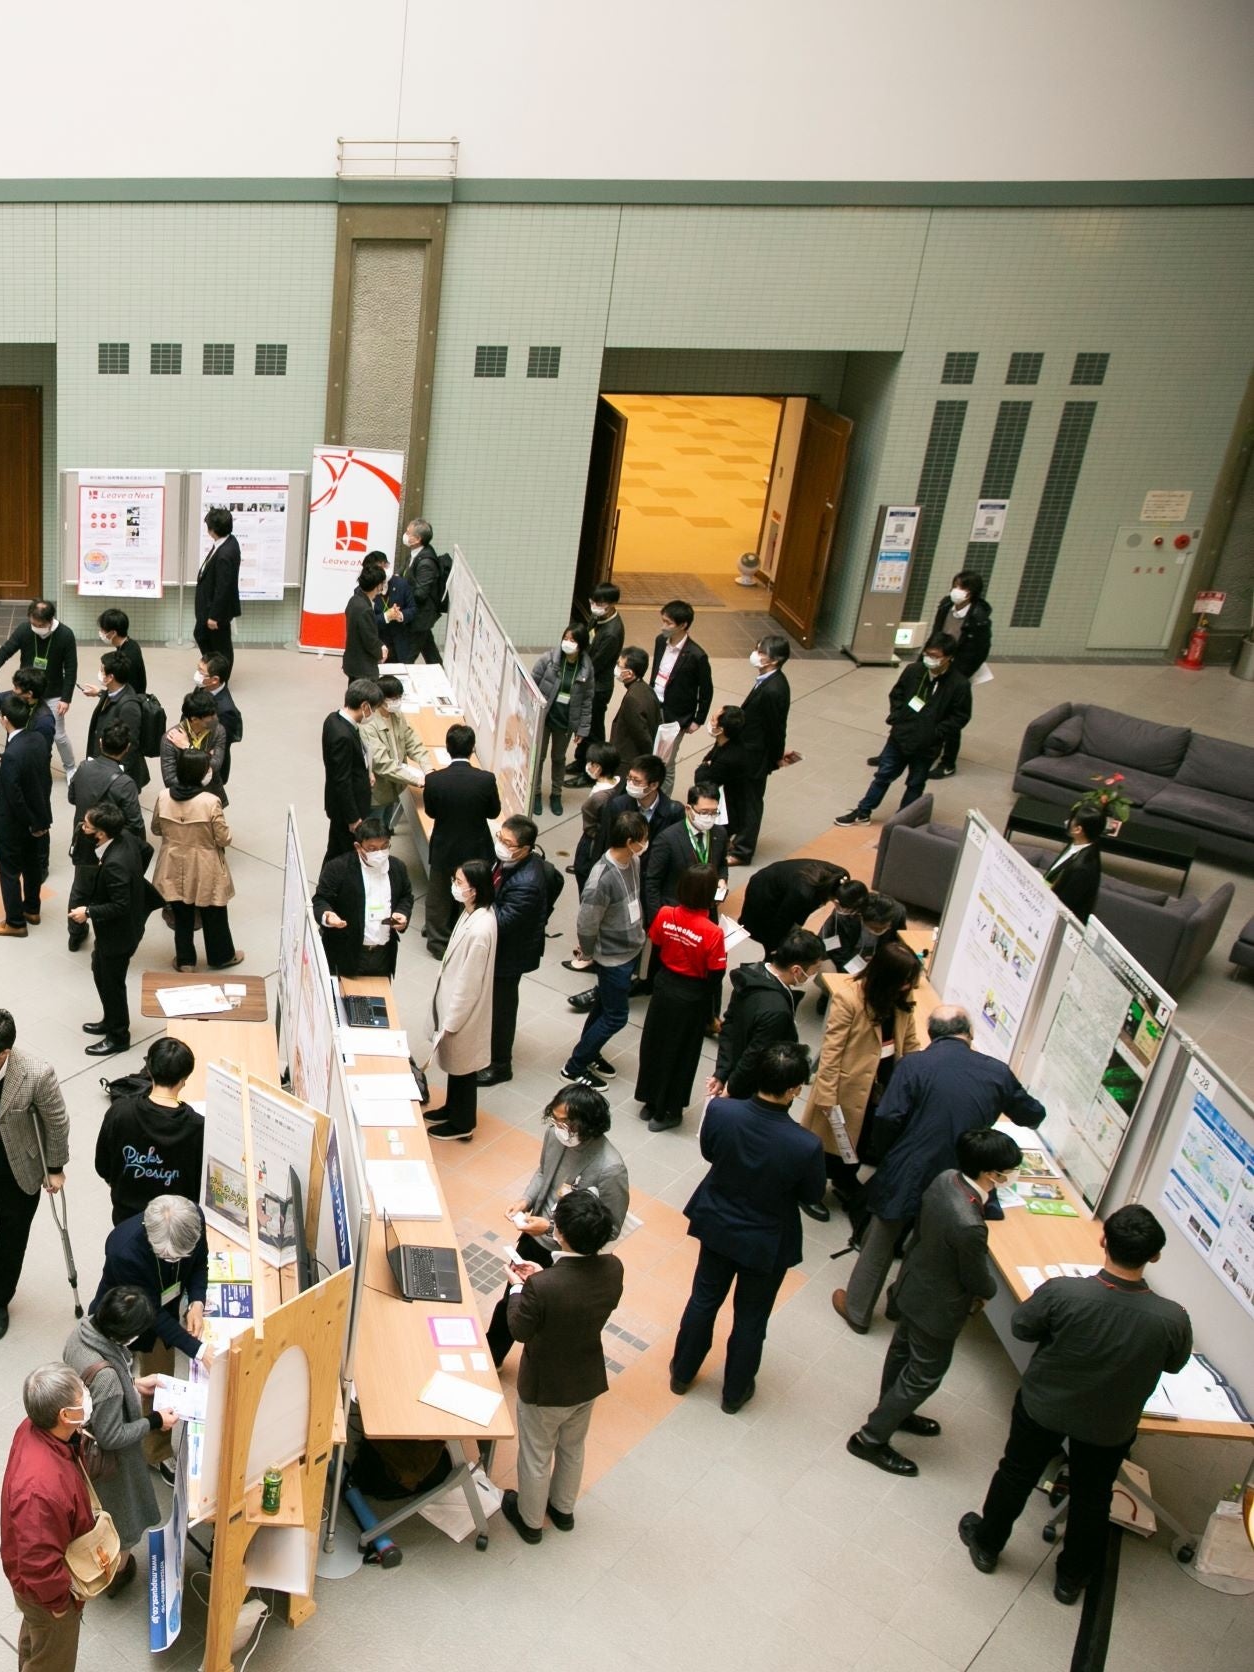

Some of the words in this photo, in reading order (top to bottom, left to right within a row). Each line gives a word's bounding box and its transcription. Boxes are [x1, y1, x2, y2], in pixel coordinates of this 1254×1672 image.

[101, 490, 127, 499] Leave
[135, 490, 154, 499] Nest
[322, 556, 349, 565] Leave
[1193, 1068, 1210, 1091] P-28
[123, 1145, 163, 1164] Picks
[124, 1164, 180, 1186] Design
[151, 1554, 161, 1624] www.mapquest.co.jp
